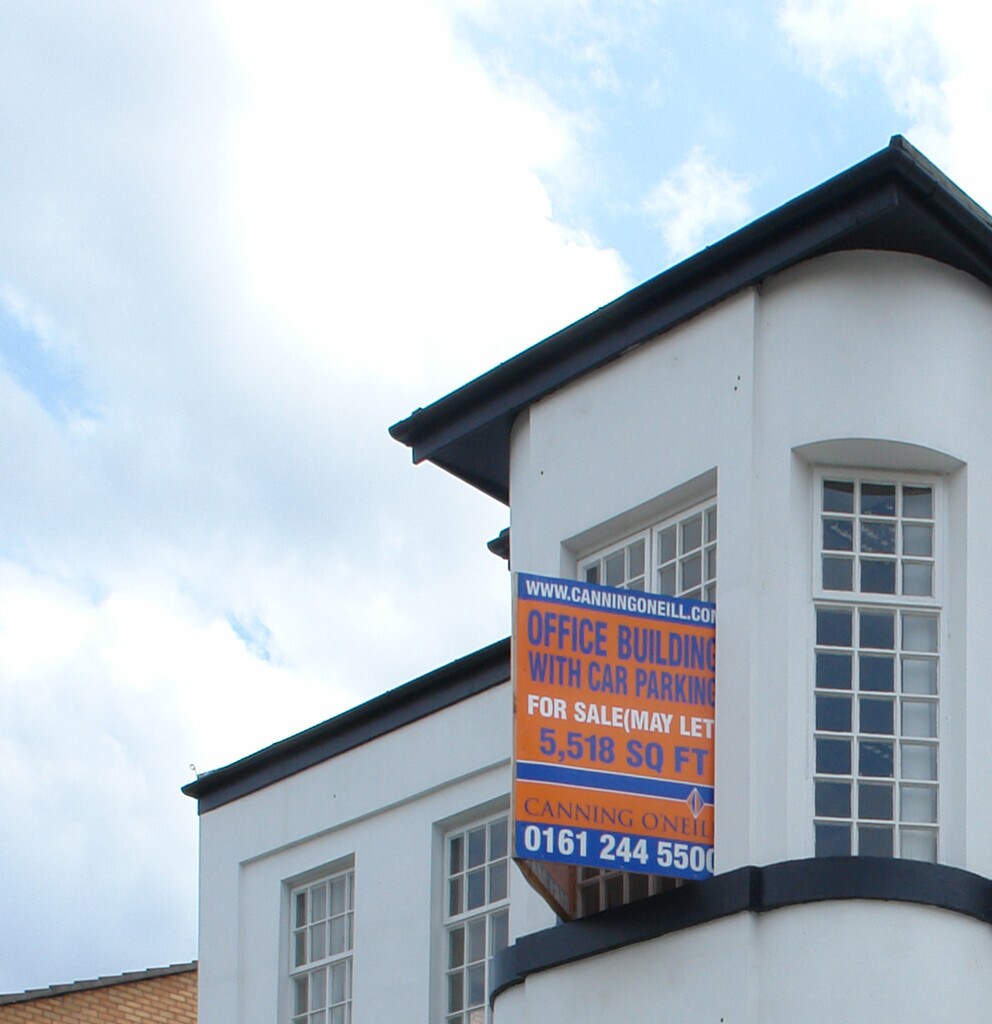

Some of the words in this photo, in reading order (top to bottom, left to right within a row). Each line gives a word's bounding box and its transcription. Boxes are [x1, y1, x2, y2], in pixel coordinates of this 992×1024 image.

[528, 610, 608, 656] OFFICE
[617, 625, 715, 672] BUILDING
[528, 651, 581, 689] WITH
[588, 661, 628, 695] CAR
[527, 694, 567, 720] FOR
[679, 715, 715, 739] LET
[539, 727, 615, 764] 5,518
[626, 739, 664, 774] SQ
[674, 746, 709, 776] FT
[524, 797, 633, 828] CANNING
[641, 812, 715, 839] O'NEIL
[524, 825, 588, 857] 0161
[600, 834, 648, 865] 244
